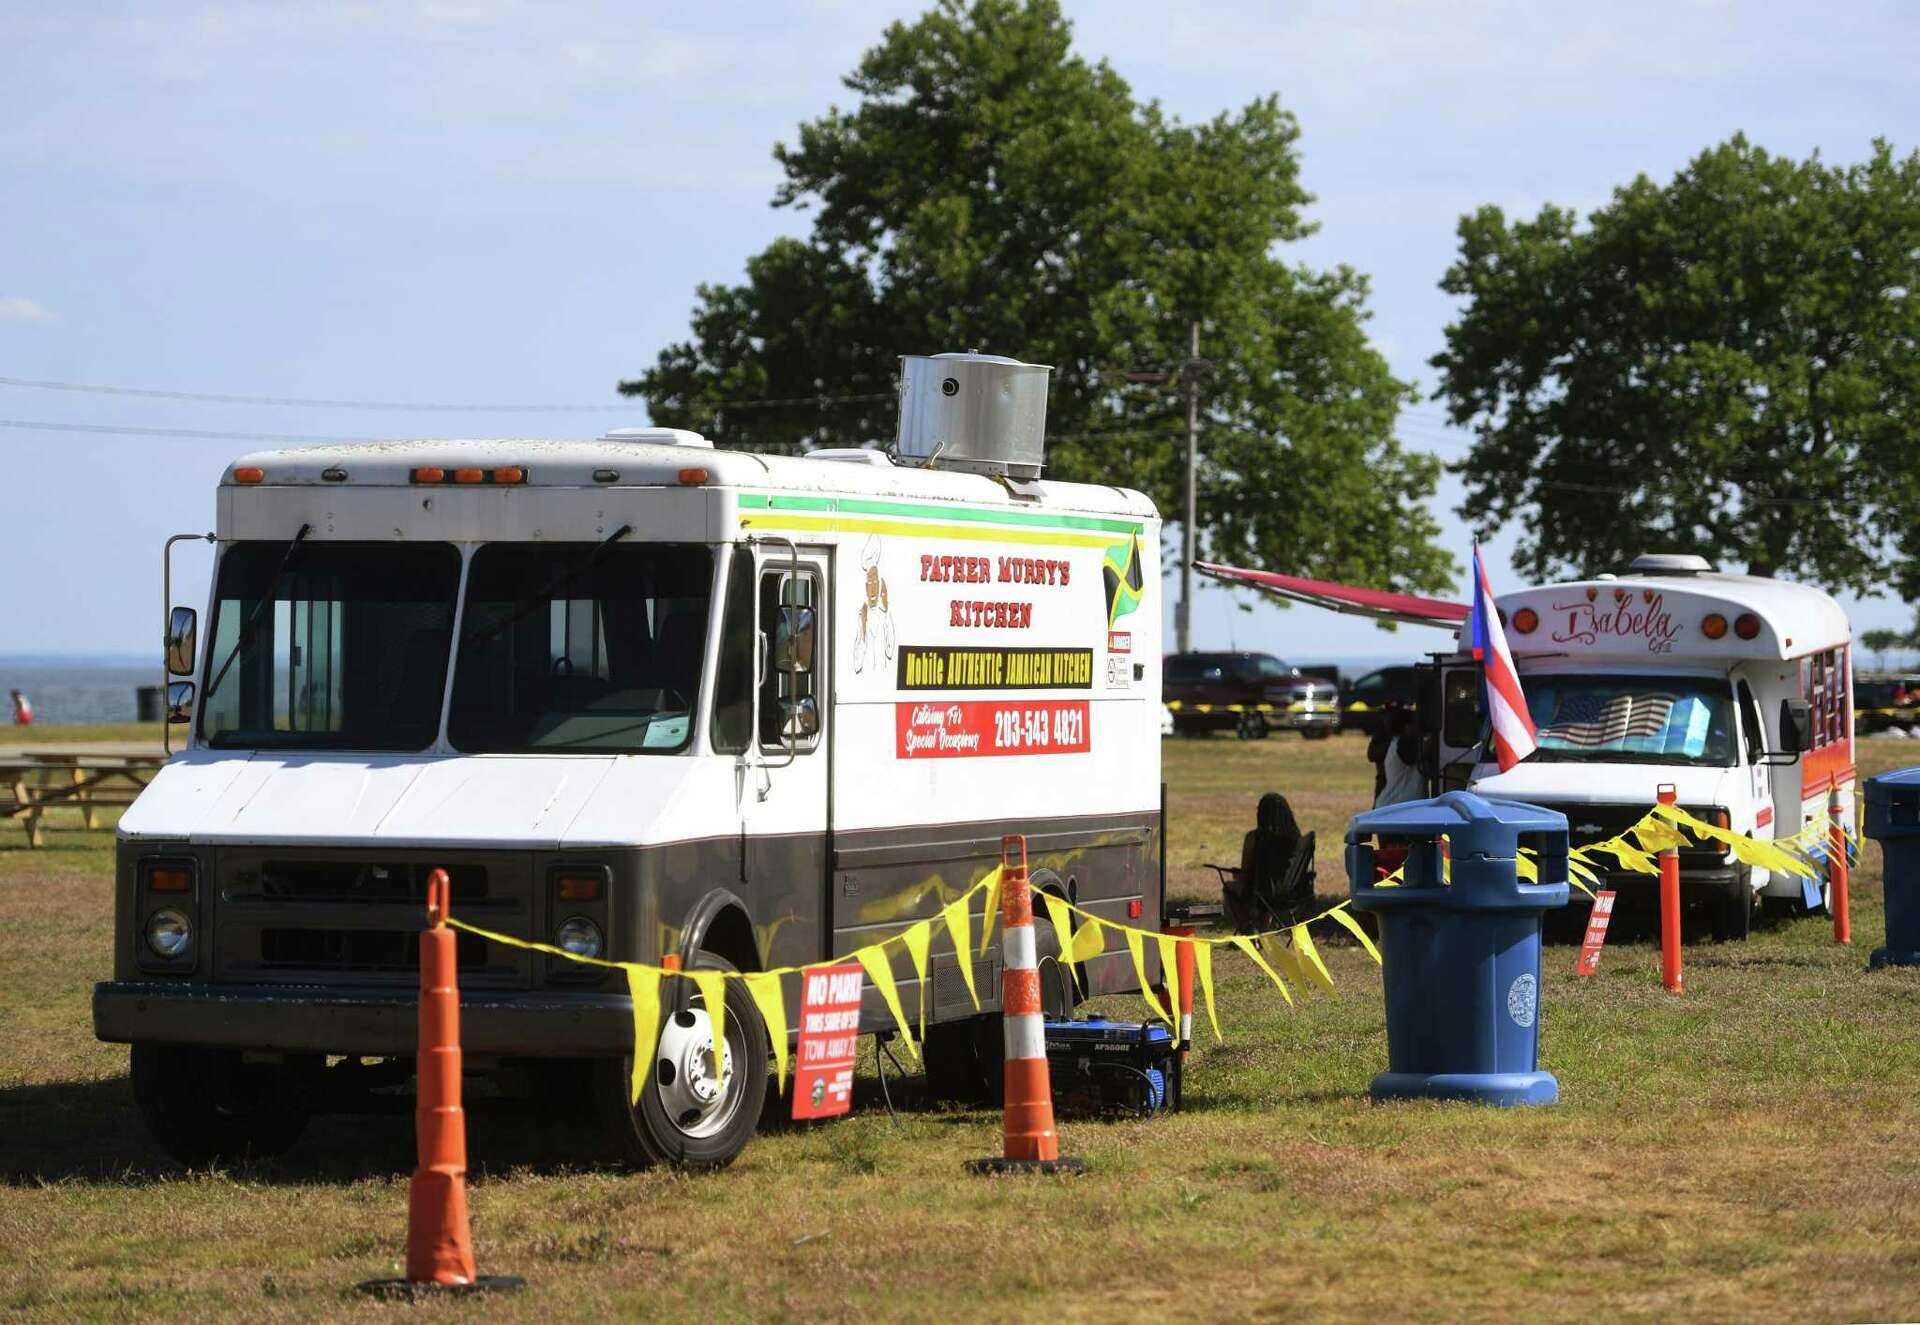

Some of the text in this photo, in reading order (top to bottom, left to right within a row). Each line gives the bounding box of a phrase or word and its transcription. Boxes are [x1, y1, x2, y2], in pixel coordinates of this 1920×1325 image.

[920, 554, 1071, 587] FATHER MURRY'S
[950, 600, 1033, 628] KITCHEN
[906, 652, 944, 686] Mobile
[947, 652, 1003, 686] AUTHENTIC
[1005, 653, 1052, 685] JAMAICAN
[1053, 653, 1091, 685] KITCHEN
[912, 704, 963, 732] Catering For
[994, 709, 1083, 747] 203-543 4821
[905, 728, 980, 757] Special Occasions
[807, 974, 828, 1006] NO
[803, 1039, 827, 1062] TOW
